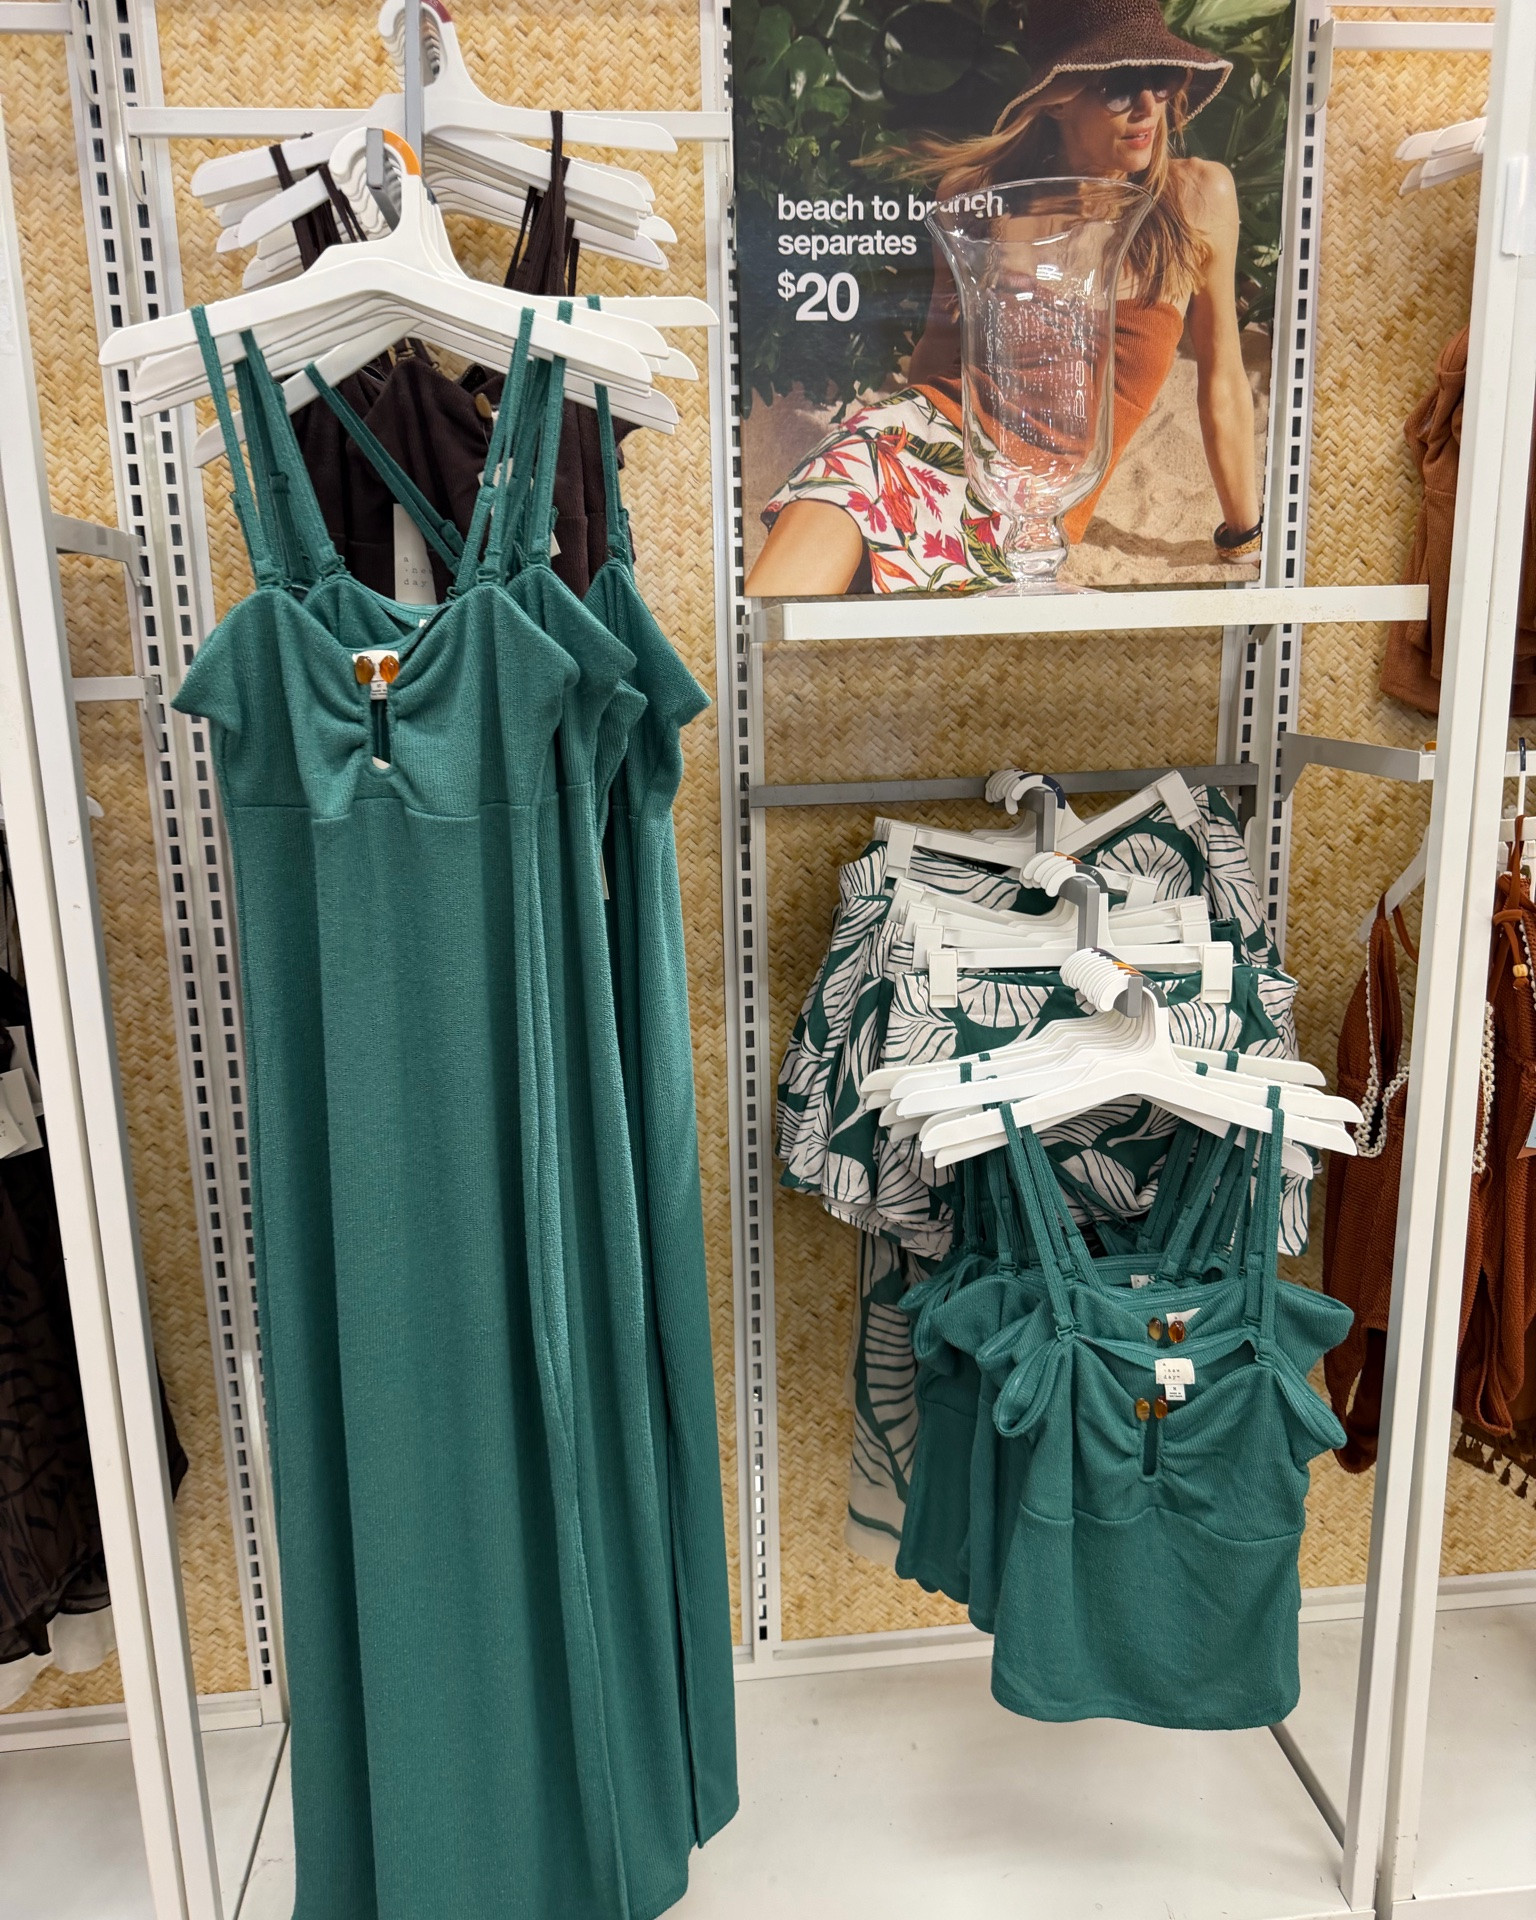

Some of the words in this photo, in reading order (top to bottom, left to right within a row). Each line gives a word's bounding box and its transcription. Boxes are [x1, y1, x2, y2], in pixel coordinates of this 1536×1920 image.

[778, 194, 864, 221] beach
[872, 195, 900, 221] to
[908, 191, 1004, 221] brunch
[778, 229, 917, 260] separates
[777, 269, 860, 322] $20
[1148, 982, 1156, 990] M
